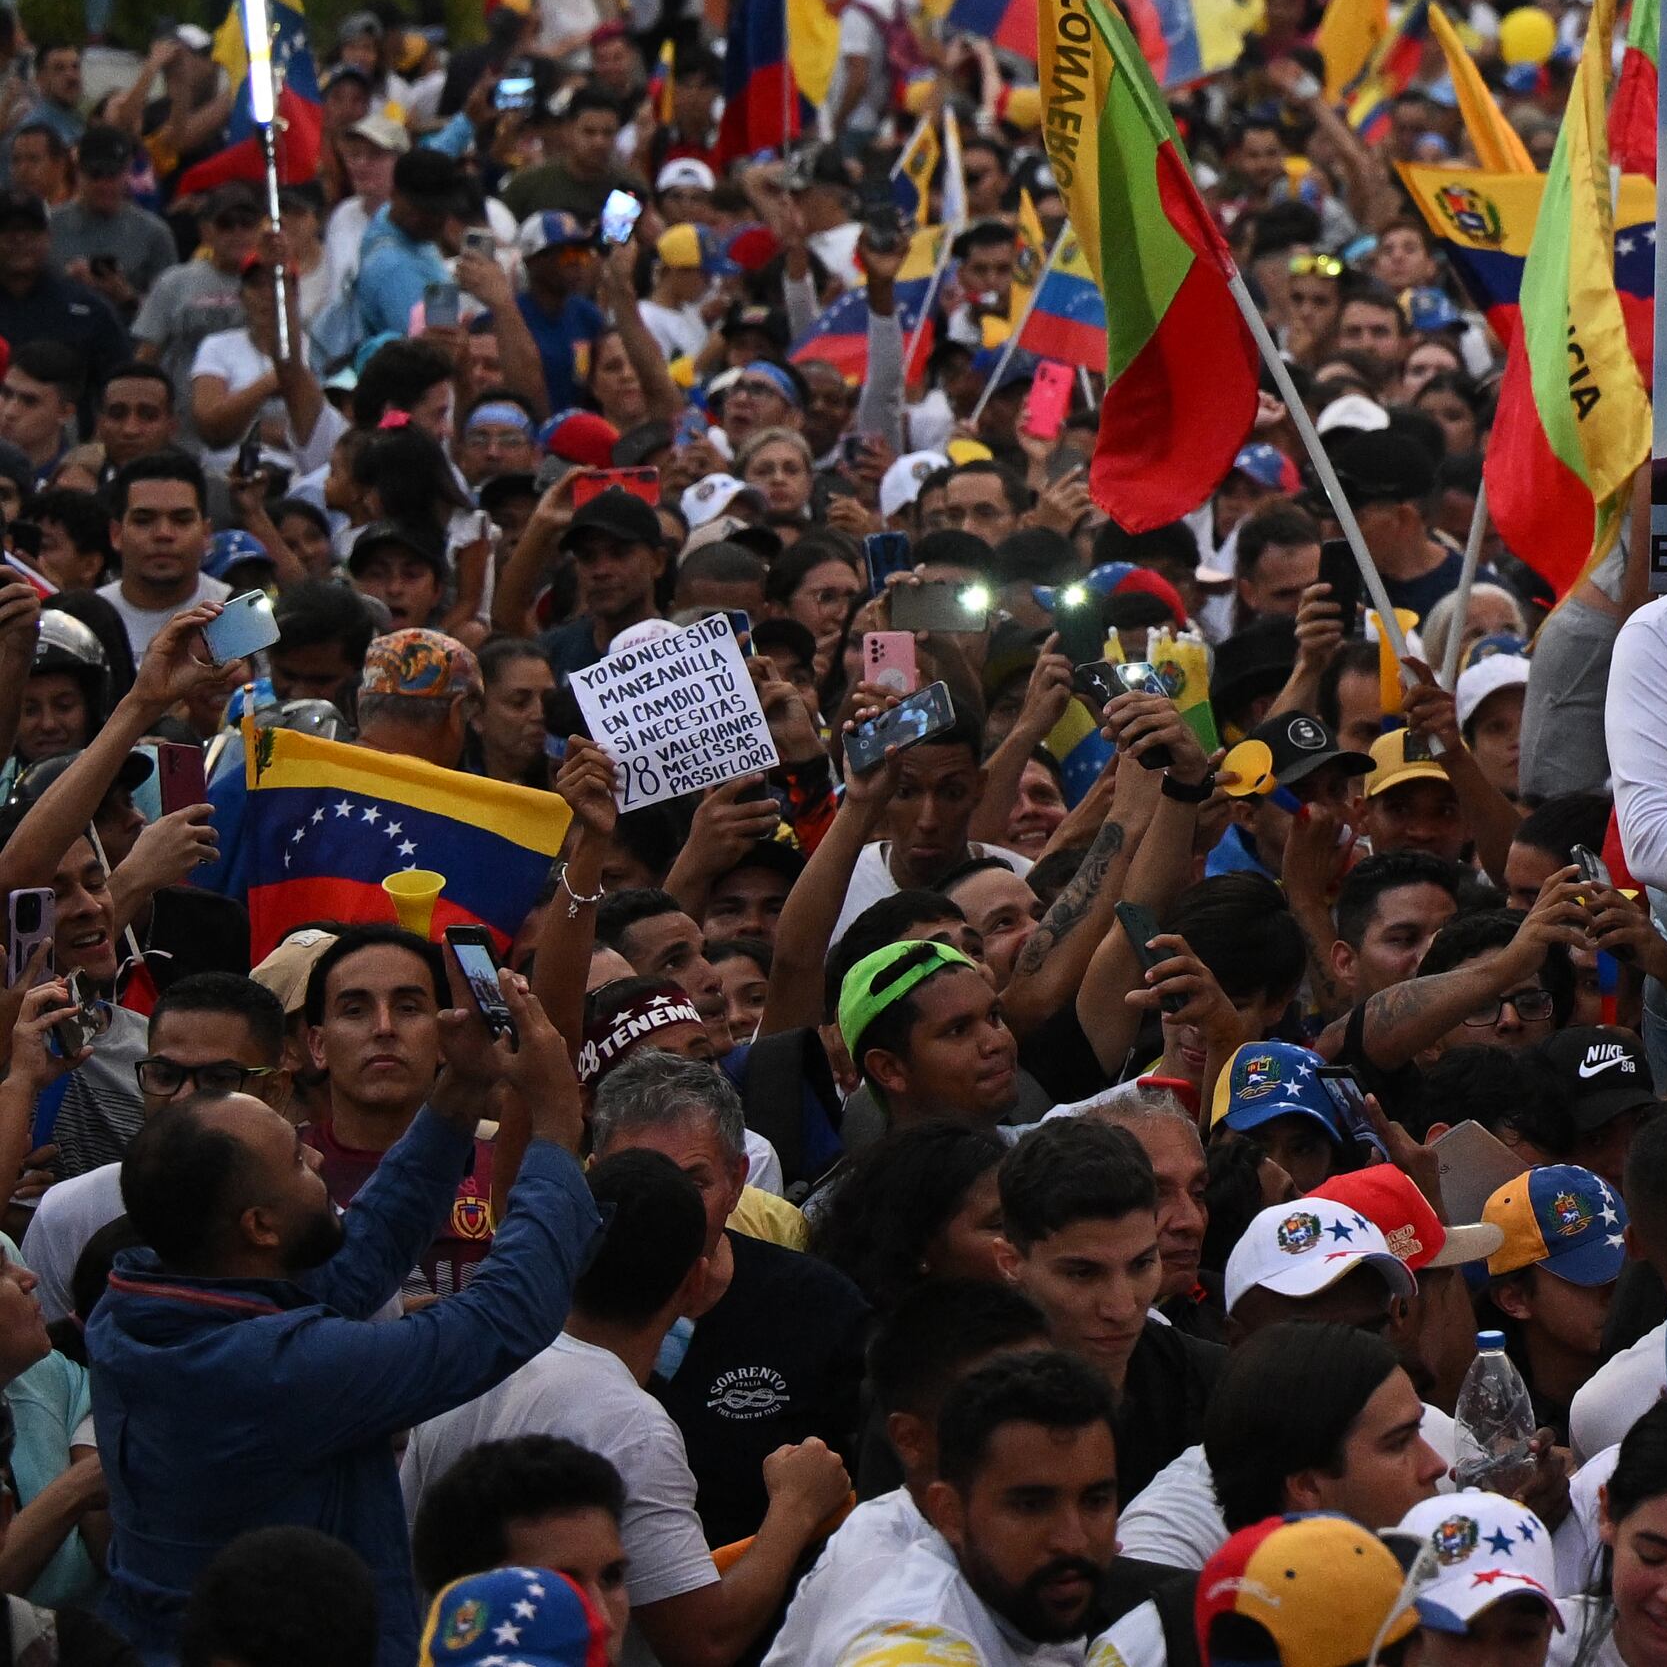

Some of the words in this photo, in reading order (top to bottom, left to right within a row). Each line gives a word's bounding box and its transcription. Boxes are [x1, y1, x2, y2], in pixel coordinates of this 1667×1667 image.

[580, 670, 607, 689] YO
[608, 653, 637, 677] NO
[601, 710, 629, 734] EN
[633, 683, 705, 723] CAMBIO
[705, 666, 735, 696] TÚ
[638, 693, 746, 747] NECESITAS
[655, 711, 762, 762] VALERIANAS
[661, 733, 758, 779] MELISSAS
[617, 755, 660, 805] 28
[669, 743, 774, 795] PASSIFLORA
[578, 1039, 601, 1082] 28
[598, 1004, 703, 1058] TENEMO
[1586, 1044, 1625, 1064] NIKE
[710, 1366, 787, 1395] SORRENTO
